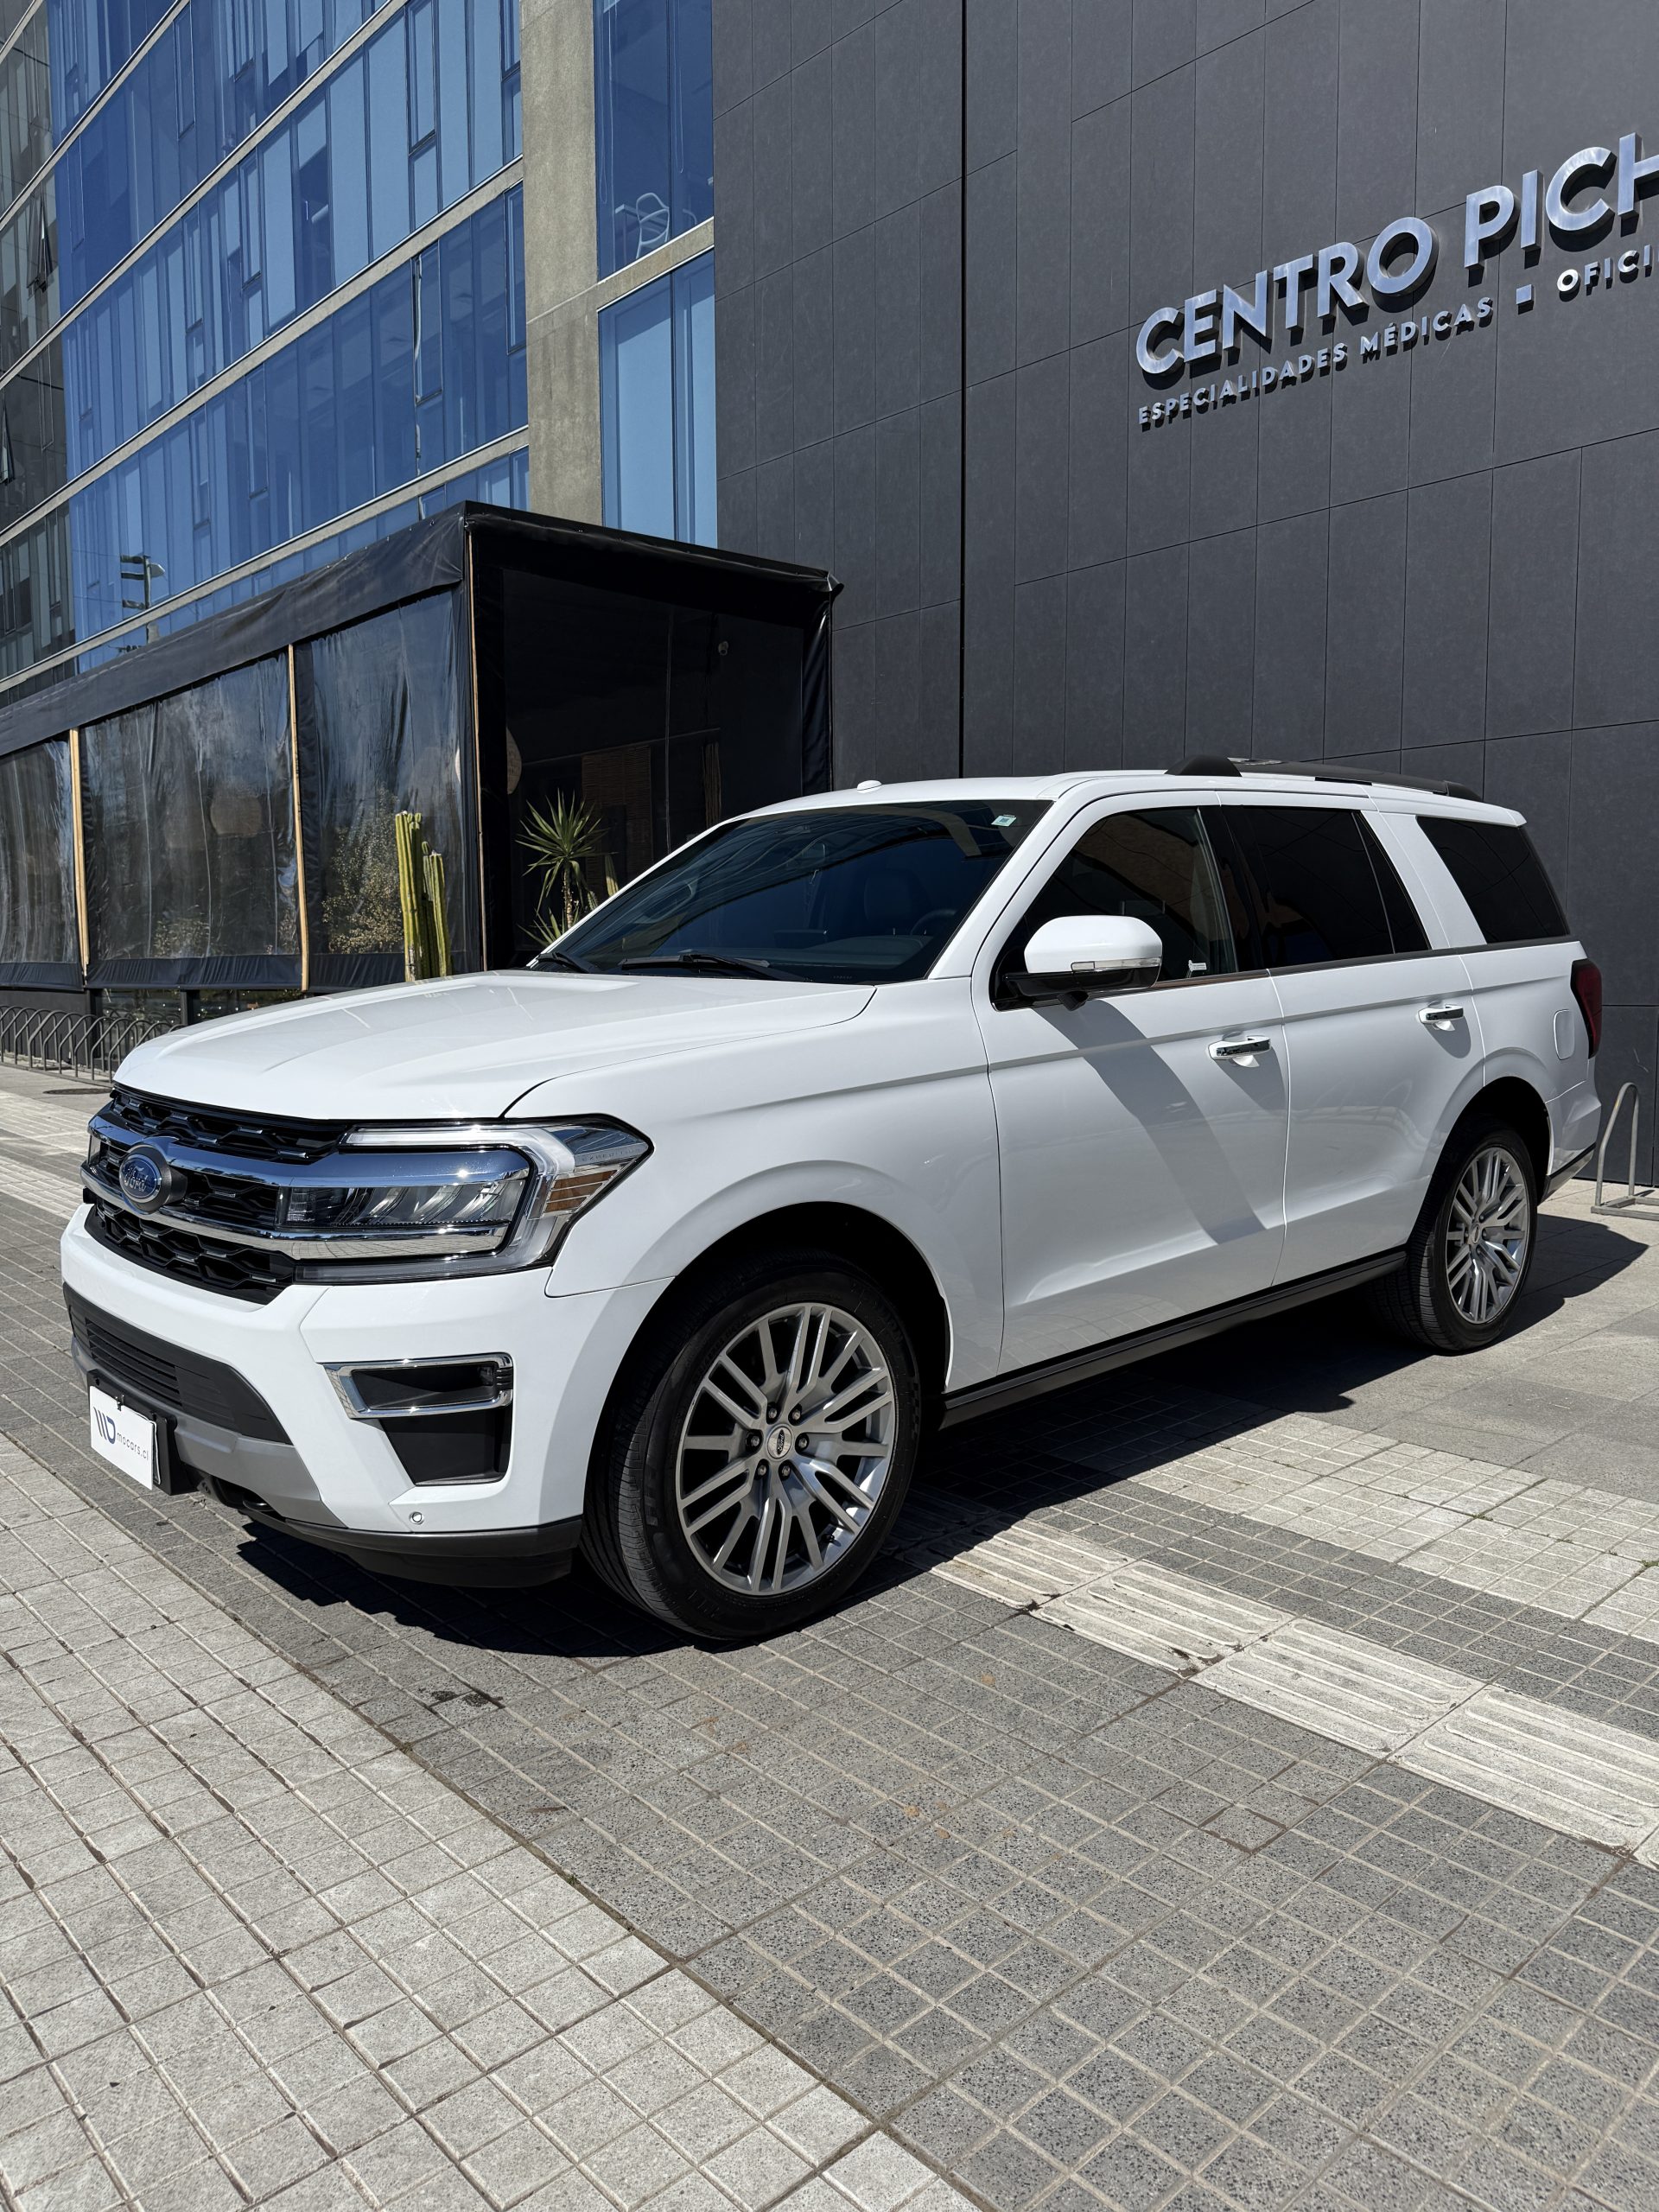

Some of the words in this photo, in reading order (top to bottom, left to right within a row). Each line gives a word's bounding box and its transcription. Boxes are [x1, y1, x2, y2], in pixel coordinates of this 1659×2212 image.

[1136, 217, 1434, 375] CENTRO
[1139, 343, 1348, 426] ESPECIALIDADES
[1360, 297, 1493, 356] MÉDICAS
[1557, 244, 1659, 292] OFICI
[124, 1165, 149, 1192] Ford
